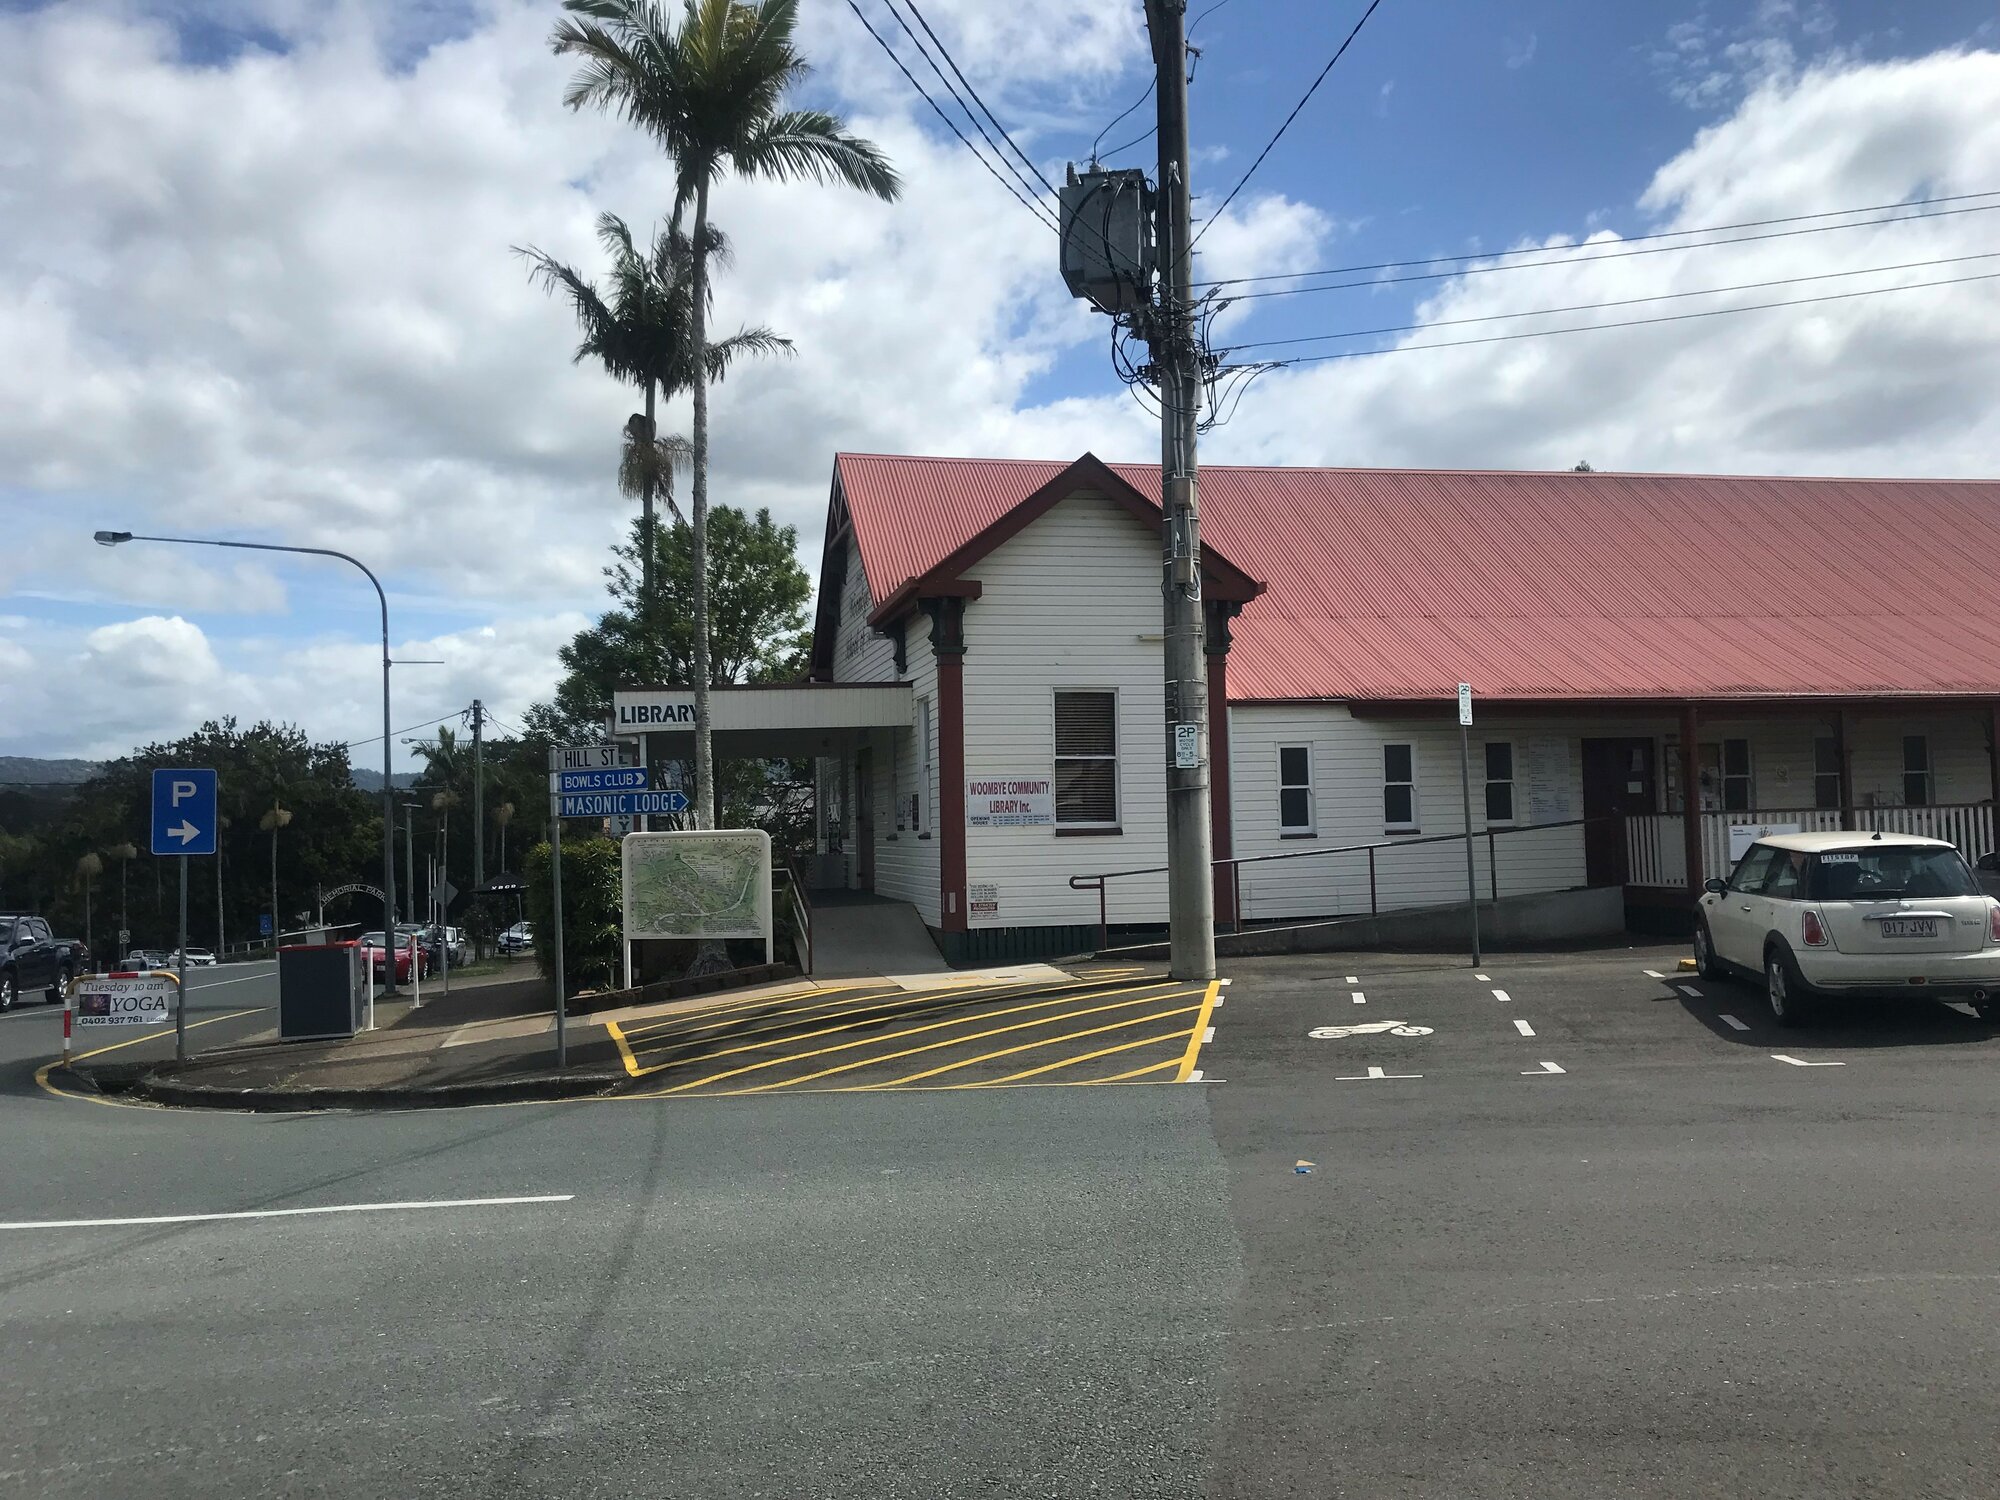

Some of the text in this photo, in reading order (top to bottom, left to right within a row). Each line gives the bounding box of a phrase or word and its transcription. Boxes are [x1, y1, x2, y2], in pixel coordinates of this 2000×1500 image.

[620, 705, 696, 724] LIBRARY
[1178, 727, 1195, 737] 2P
[565, 749, 615, 768] HILL ST
[565, 773, 634, 789] BOWLS CLUB
[970, 781, 1050, 795] WOOMBYE COMMUNITY
[172, 781, 197, 807] P
[566, 793, 678, 815] MASONIC LODGE
[989, 800, 1032, 813] LIBRARY Inc.
[321, 885, 386, 907] MEMORIAL PARK
[84, 982, 164, 993] Tuesday 10 am
[112, 996, 166, 1012] YOGA
